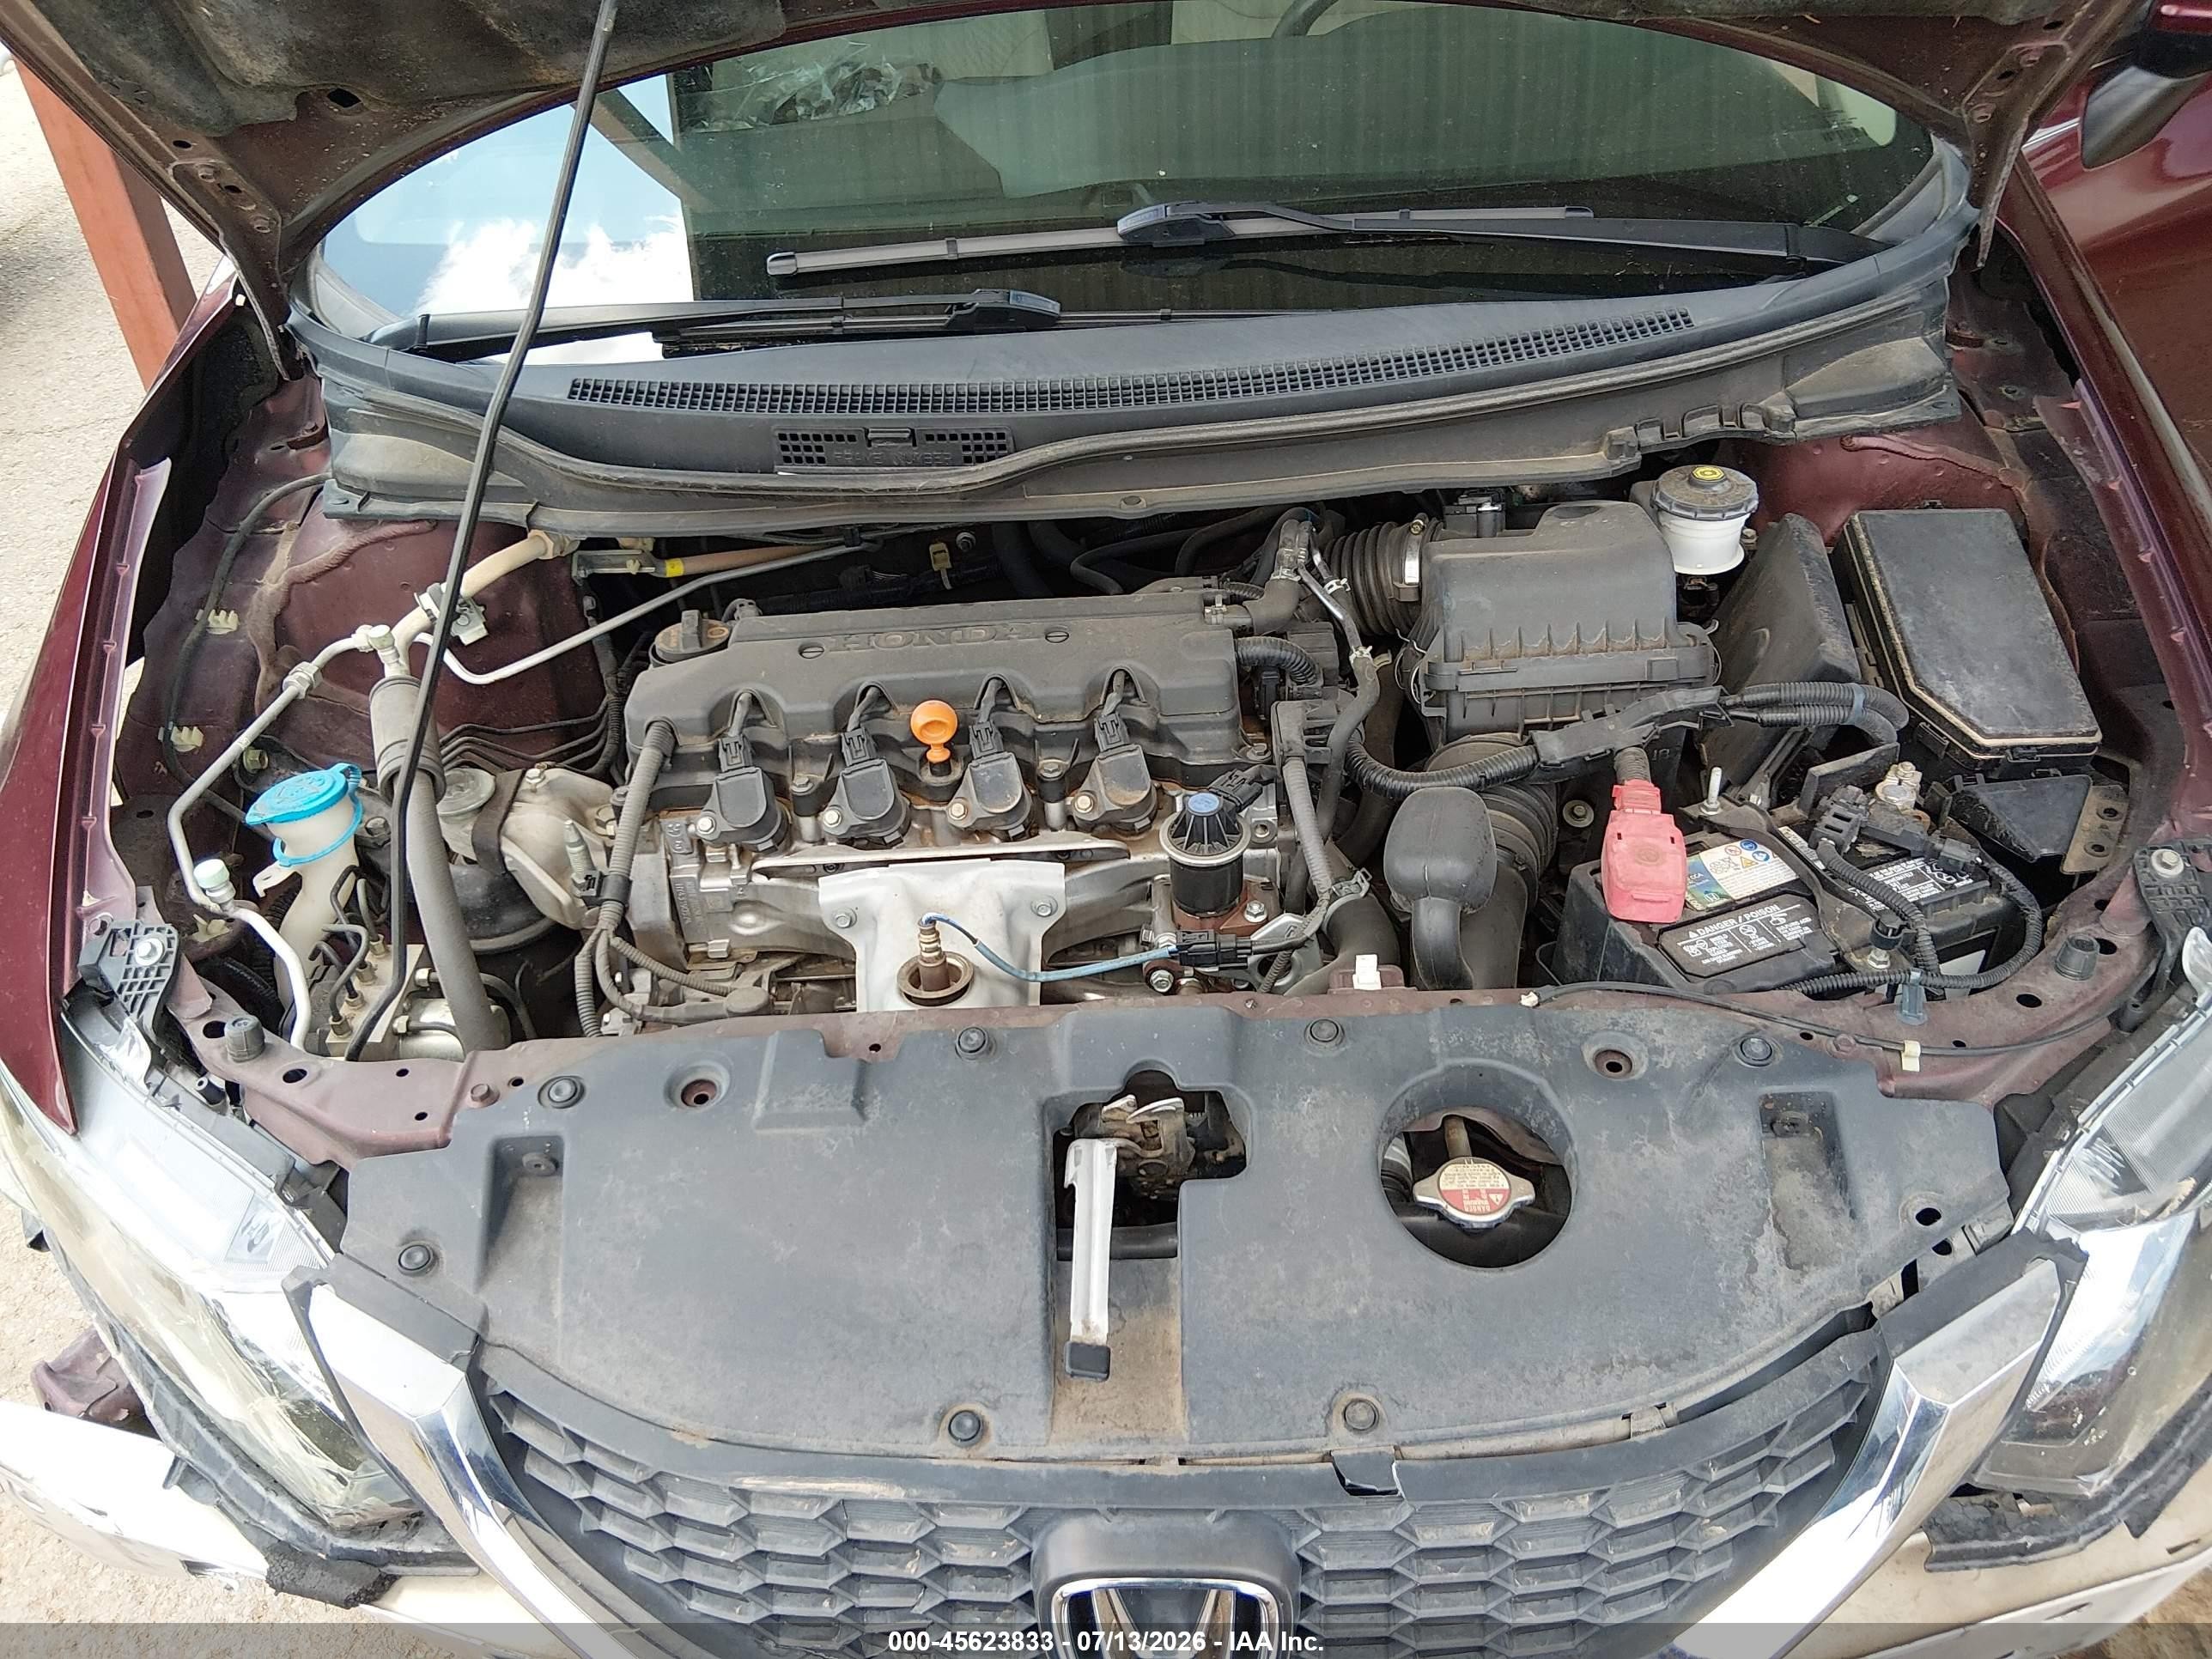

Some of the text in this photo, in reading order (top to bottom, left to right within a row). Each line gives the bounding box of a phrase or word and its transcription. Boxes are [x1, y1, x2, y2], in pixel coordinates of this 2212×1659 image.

[828, 623, 1043, 653] HONDA
[1697, 918, 1738, 936] DANGER
[1743, 904, 1781, 921] POISON
